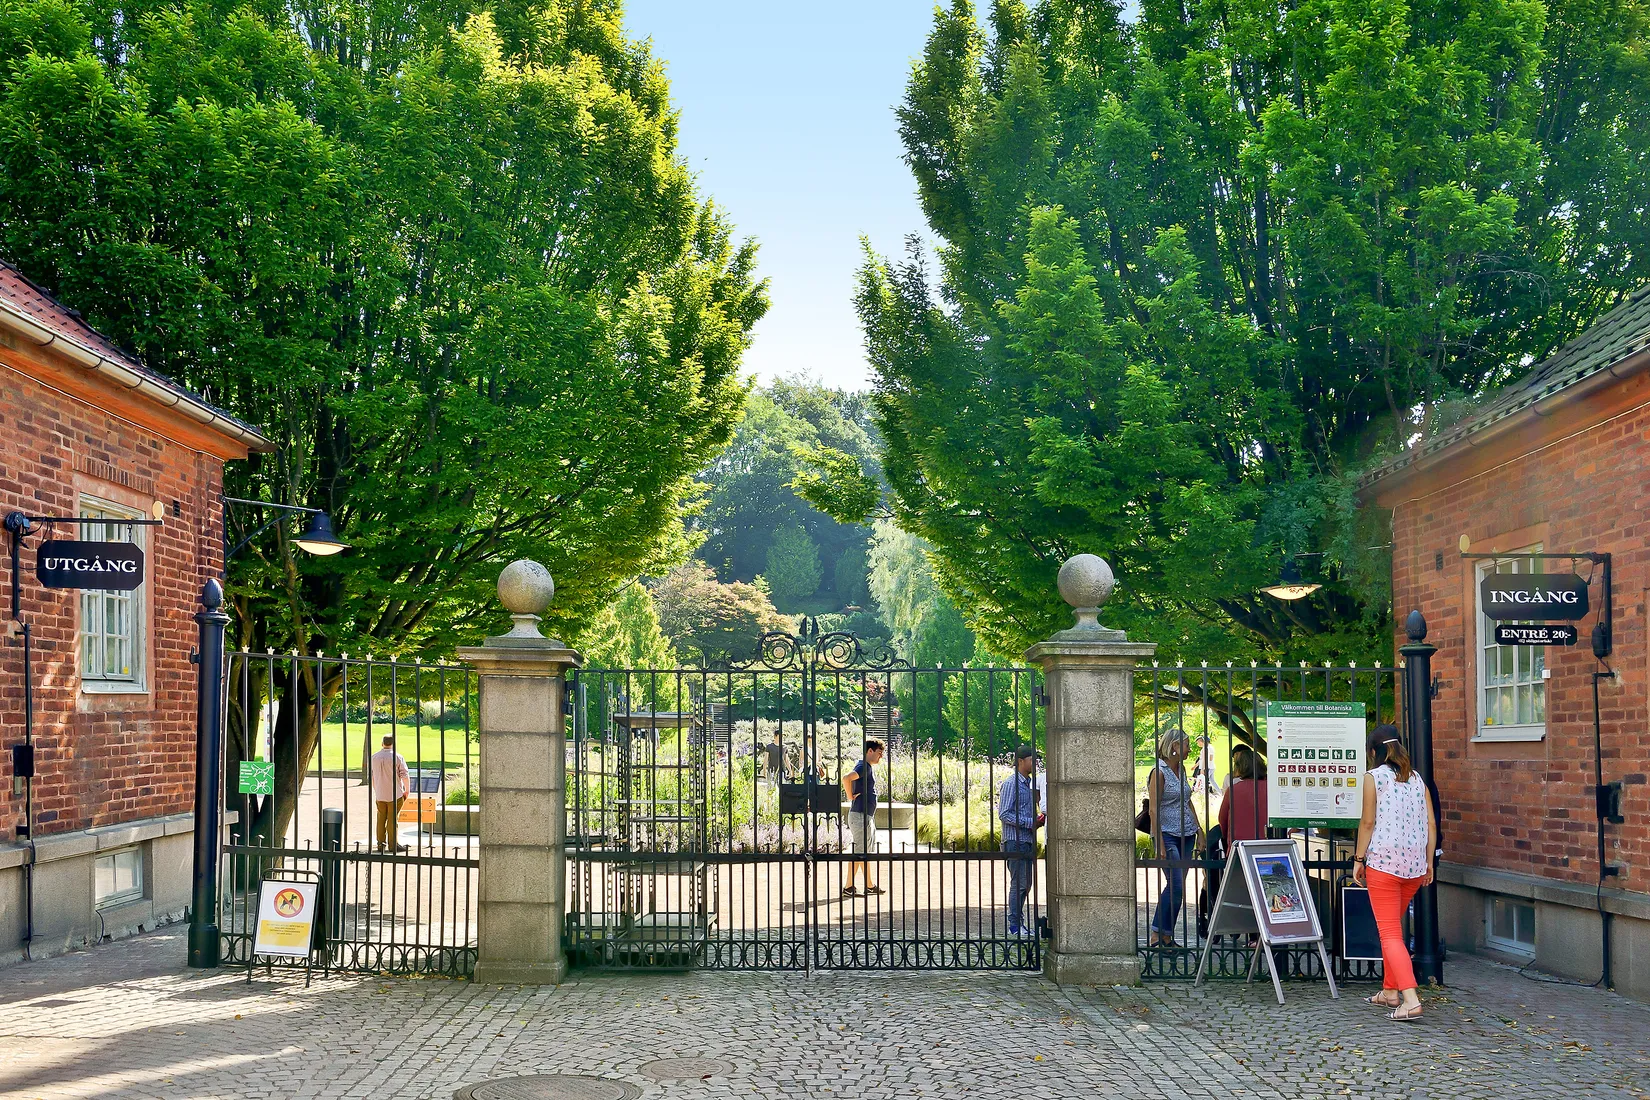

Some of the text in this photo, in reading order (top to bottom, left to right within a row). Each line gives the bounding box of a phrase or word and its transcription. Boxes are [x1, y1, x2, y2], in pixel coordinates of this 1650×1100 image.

[44, 555, 137, 573] UTGÅNG
[1490, 587, 1578, 603] INGÅNG
[1501, 628, 1571, 638] ENTRÉ 20:-
